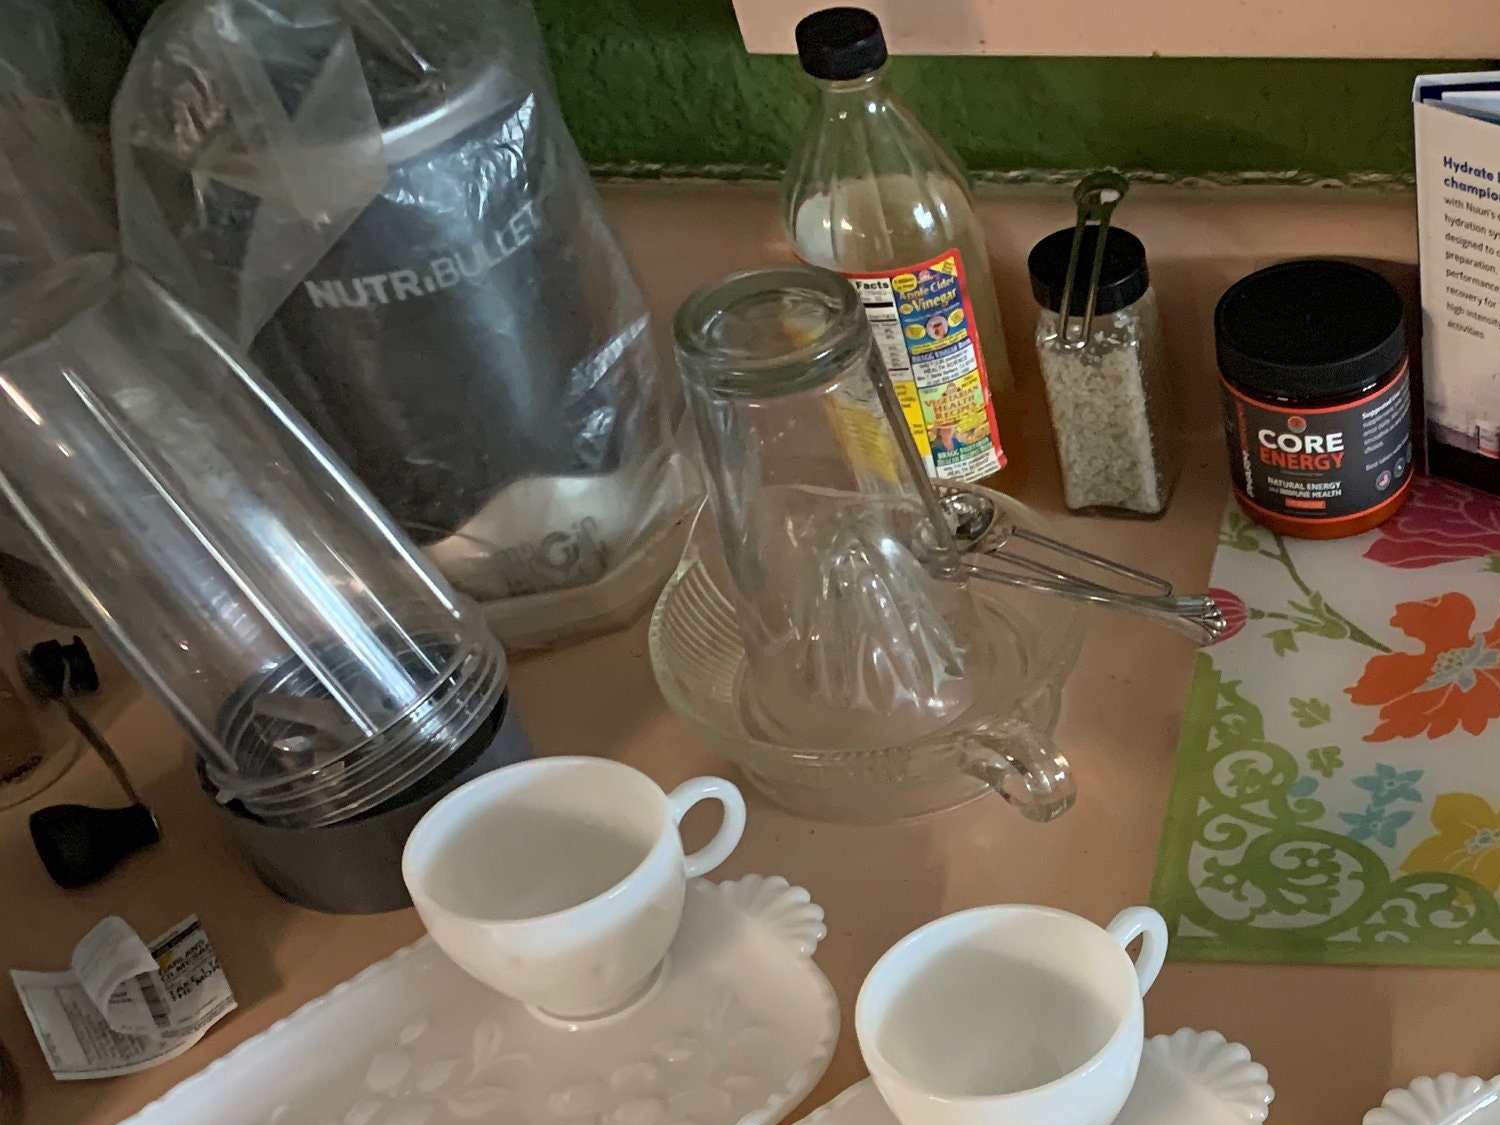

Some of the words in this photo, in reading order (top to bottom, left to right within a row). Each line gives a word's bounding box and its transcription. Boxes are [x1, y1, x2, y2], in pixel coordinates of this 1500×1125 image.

[1443, 156, 1494, 181] Hydrate
[1443, 196, 1464, 210] with
[1444, 214, 1486, 235] hydration
[1445, 232, 1483, 252] designed
[1485, 244, 1494, 255] to
[856, 281, 889, 290] Facts
[930, 277, 954, 293] Cider
[912, 288, 957, 311] Vinegar
[1446, 285, 1483, 306] recovery
[1484, 297, 1496, 309] for
[934, 394, 975, 412] HEALTH
[1258, 429, 1345, 453] CORE
[1259, 447, 1344, 471] ENERGY
[1267, 477, 1305, 490] NATURAL
[1307, 481, 1342, 491] ENERGY
[1312, 489, 1342, 498] HEALTH
